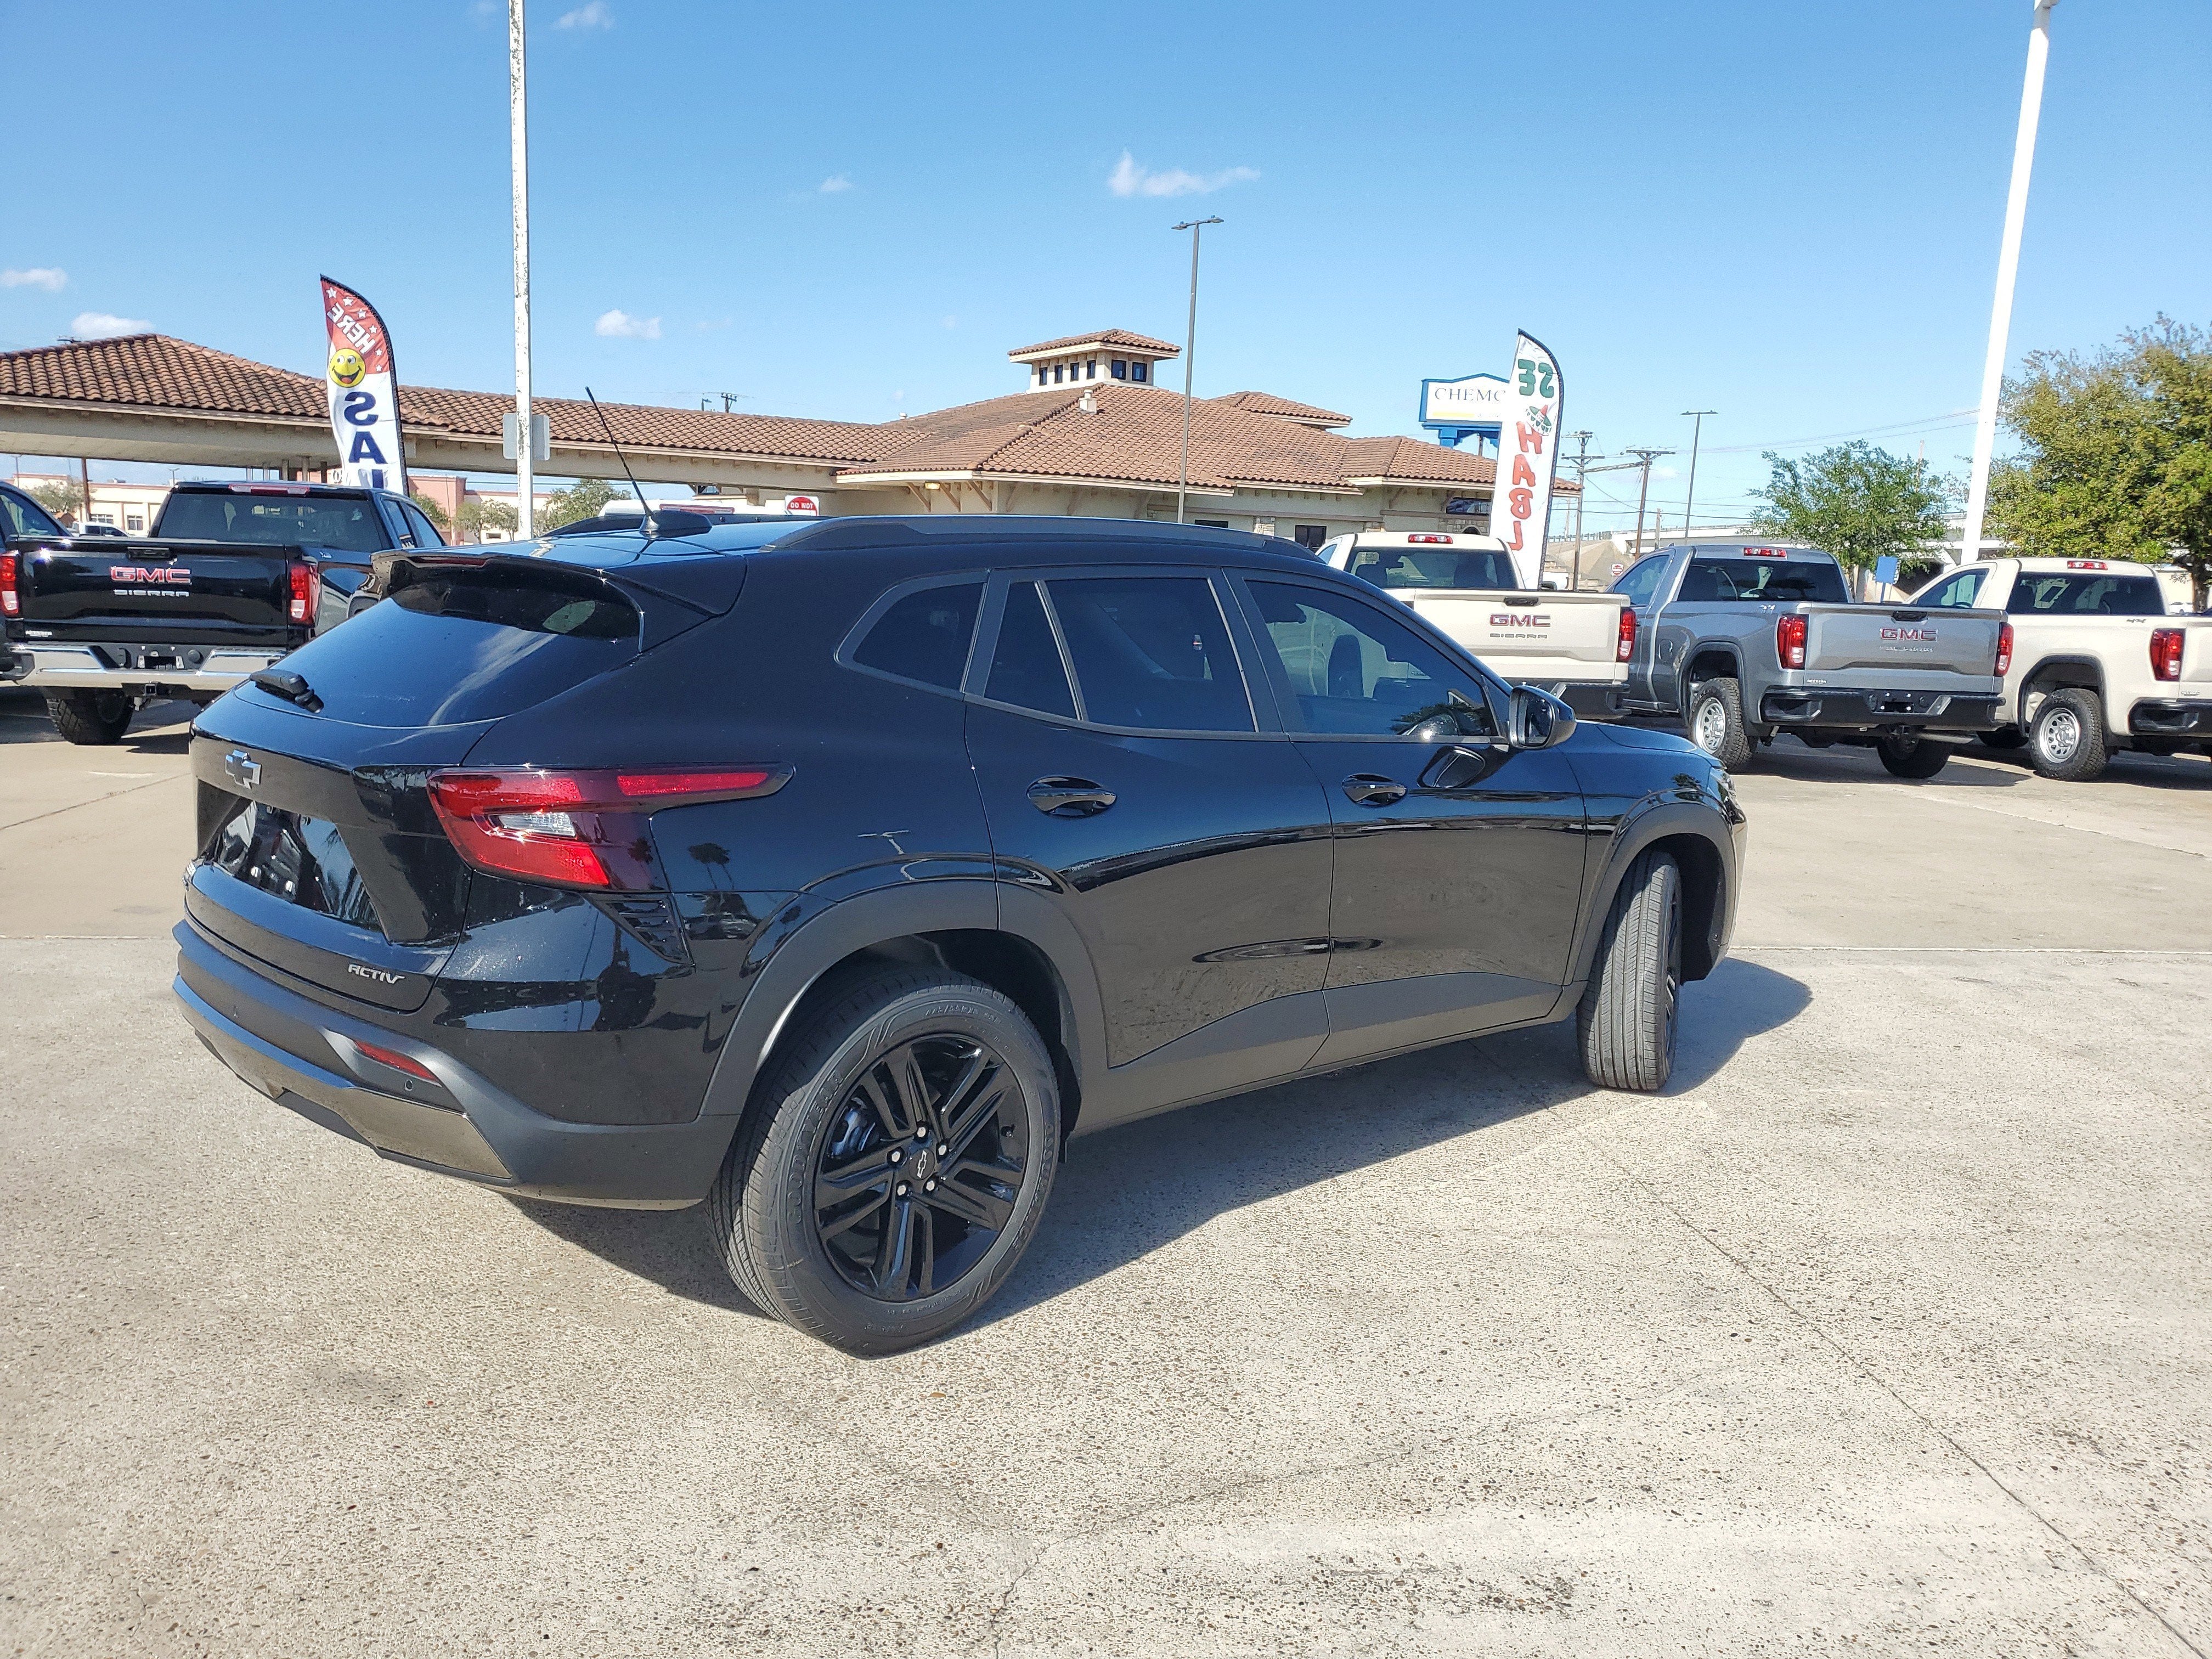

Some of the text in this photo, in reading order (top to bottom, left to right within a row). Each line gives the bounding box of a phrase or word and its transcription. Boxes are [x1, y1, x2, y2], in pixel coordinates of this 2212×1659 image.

[111, 566, 191, 584] GMC
[1489, 614, 1551, 627] GMC
[1880, 628, 1938, 642] GMC
[348, 964, 406, 984] ACTIV
